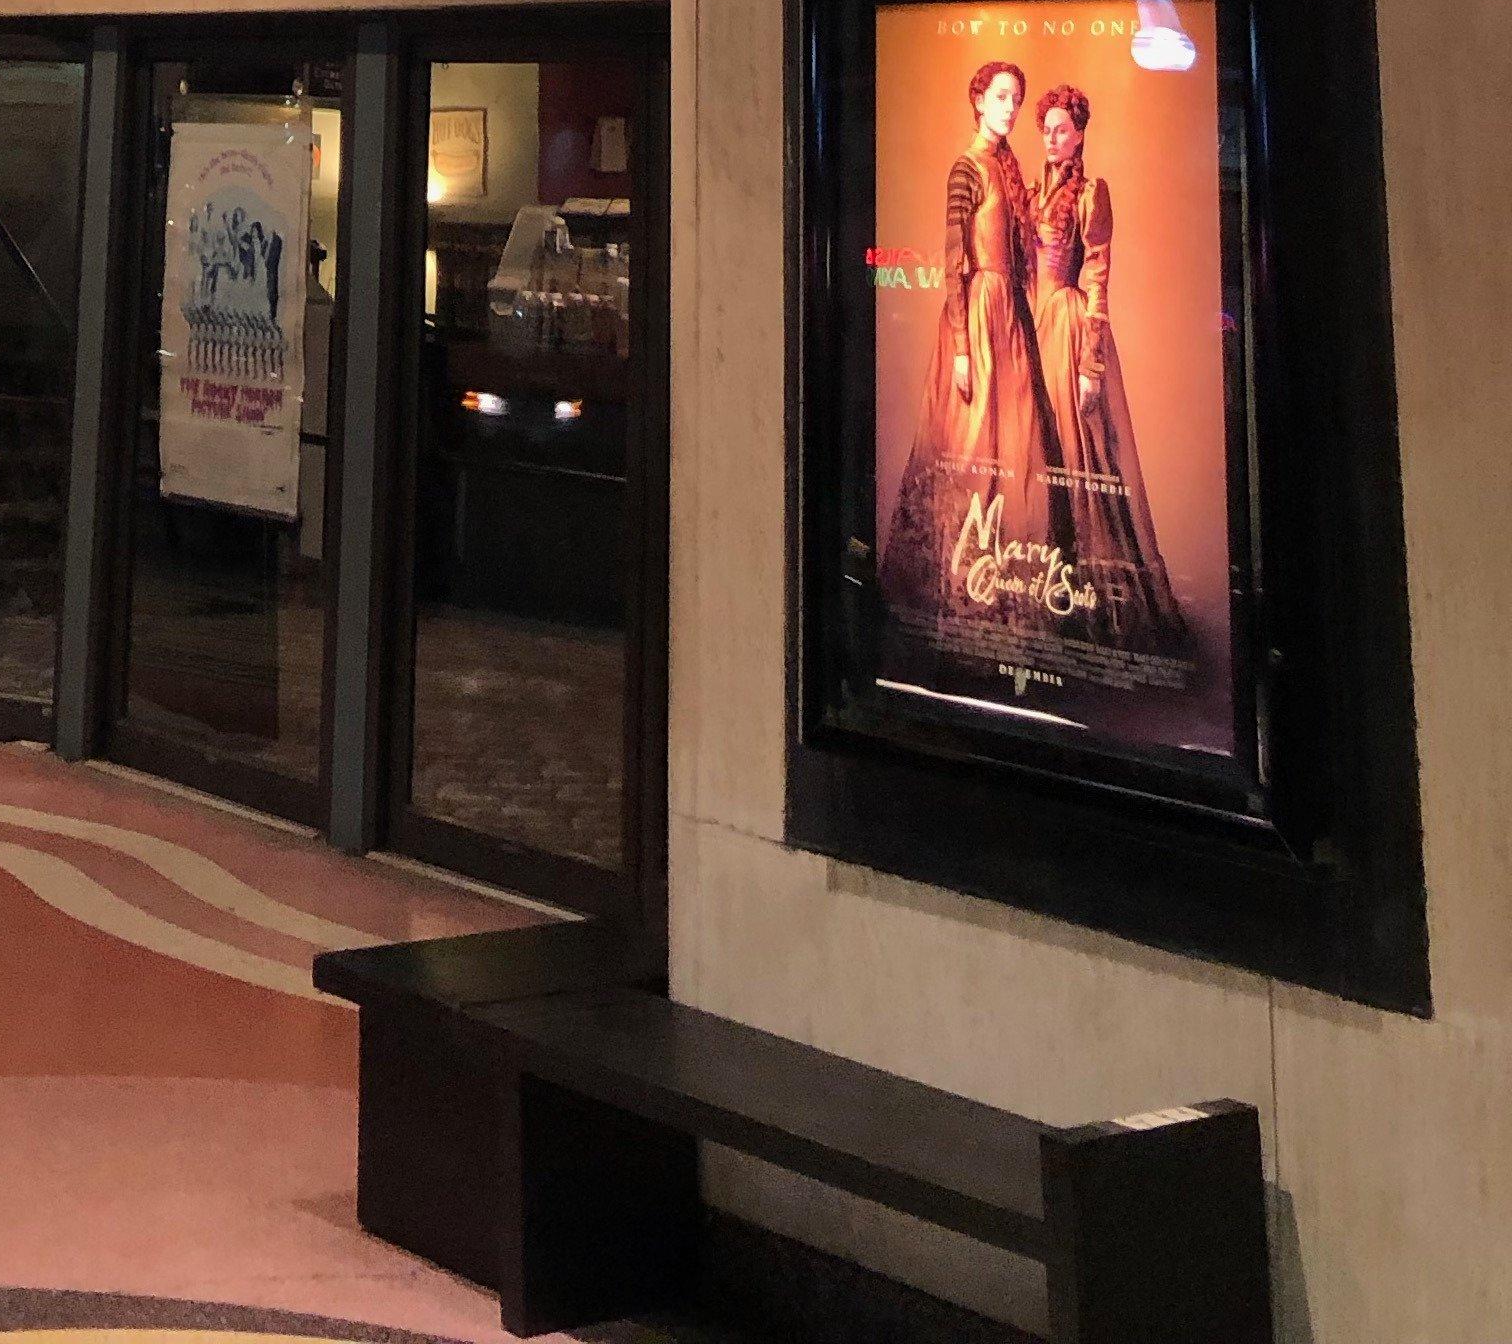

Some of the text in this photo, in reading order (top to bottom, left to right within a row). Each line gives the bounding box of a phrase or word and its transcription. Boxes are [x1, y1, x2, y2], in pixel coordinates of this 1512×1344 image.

[999, 20, 1028, 36] TO
[1042, 20, 1075, 36] NO
[951, 492, 1063, 603] Mary
